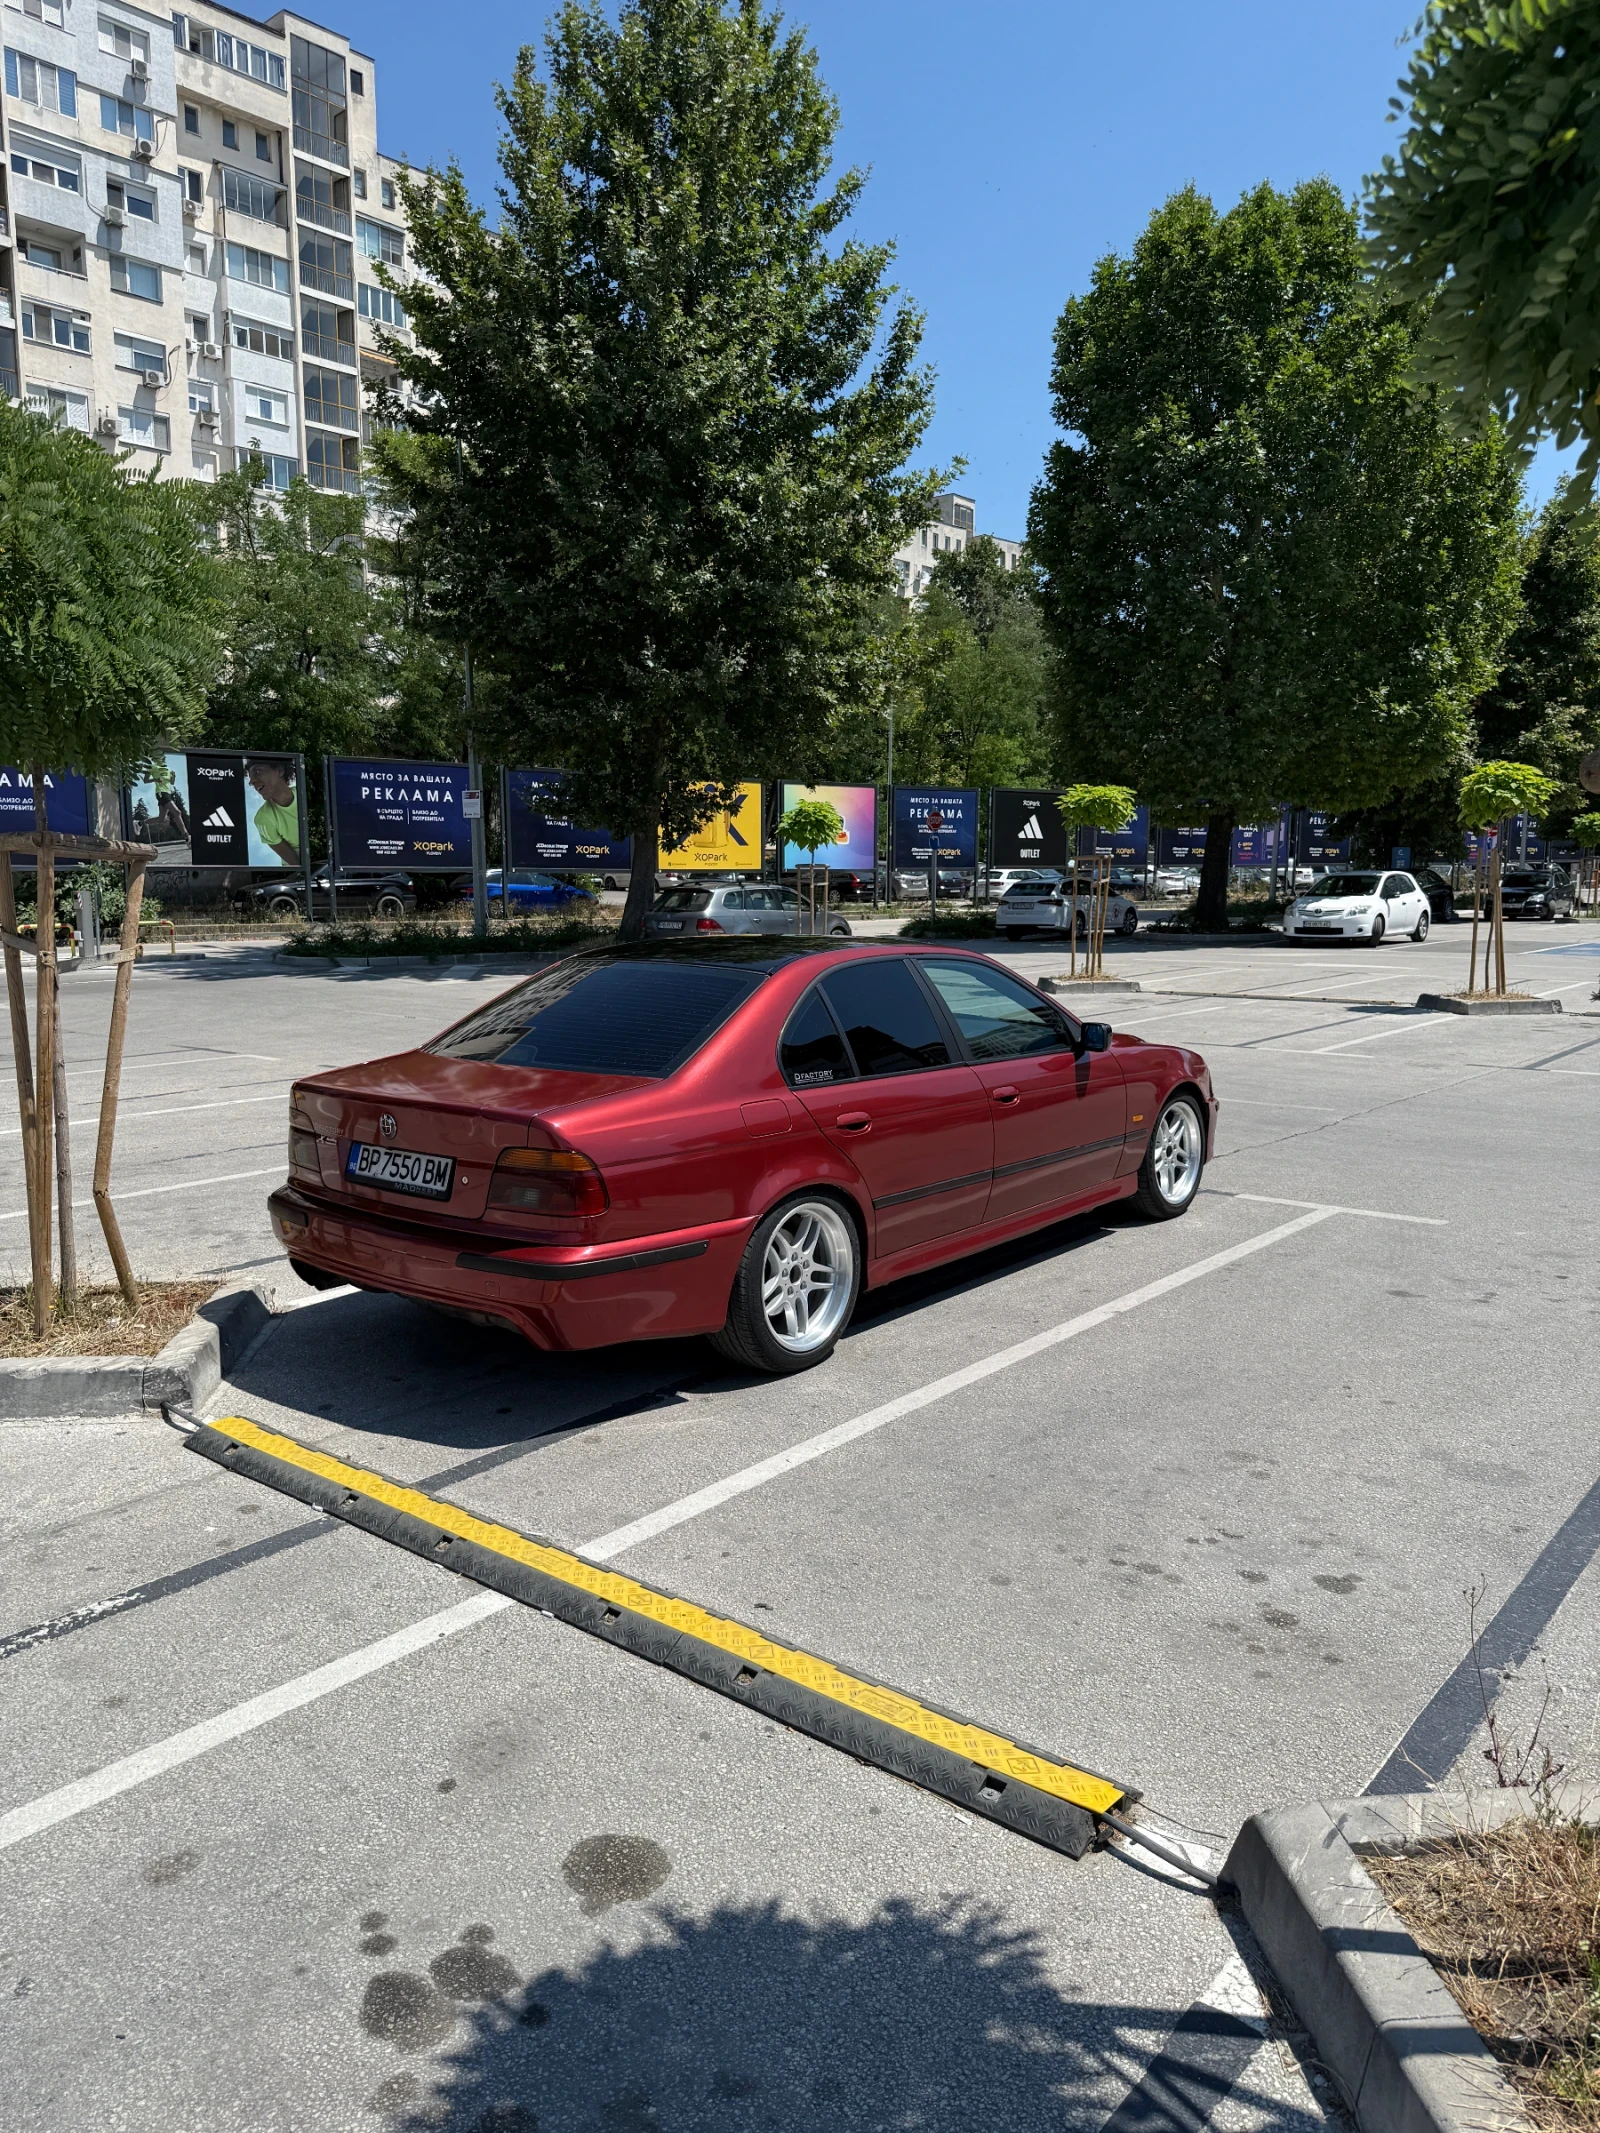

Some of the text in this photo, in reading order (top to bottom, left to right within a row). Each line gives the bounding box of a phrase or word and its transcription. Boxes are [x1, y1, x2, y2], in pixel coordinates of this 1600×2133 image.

[361, 772, 393, 780] МЯСТО
[414, 775, 452, 783] ВАШАТА
[361, 787, 453, 803] РЕКЛАМА
[910, 808, 963, 819] РЕКАМА
[207, 834, 232, 842] OUTLET
[413, 841, 454, 851] XOPark
[575, 845, 610, 854] XOPark
[694, 853, 728, 861] XOPark
[1020, 849, 1040, 858] OUTLET
[358, 1147, 449, 1187] BP 7550 BM
